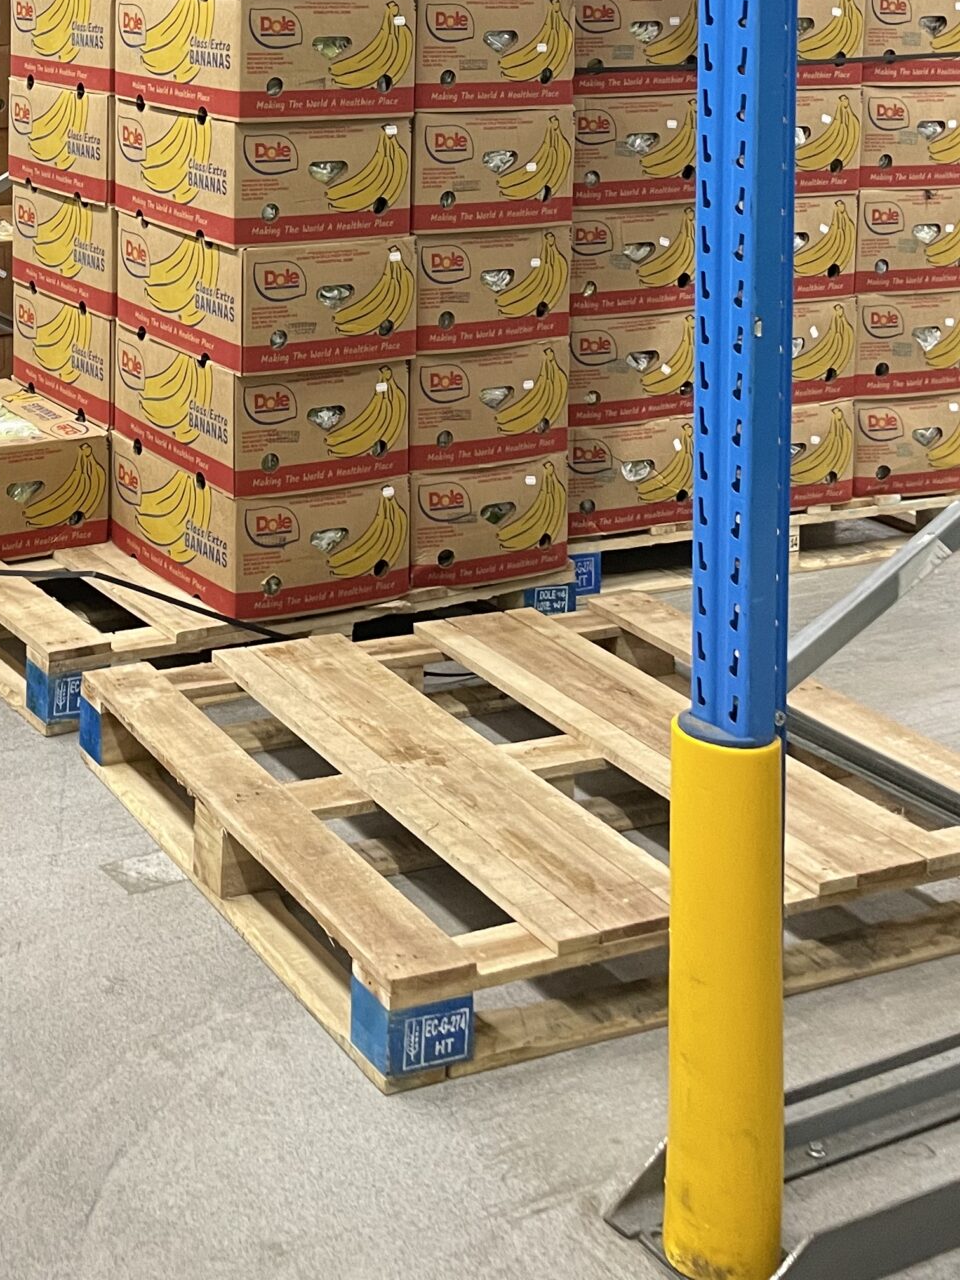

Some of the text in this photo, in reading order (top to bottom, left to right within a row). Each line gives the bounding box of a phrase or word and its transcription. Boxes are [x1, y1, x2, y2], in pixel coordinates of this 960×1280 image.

[16, 1, 34, 19] Dole
[583, 5, 614, 19] Dole
[121, 11, 144, 33] Dole
[259, 15, 296, 33] Dole
[435, 11, 468, 28] Dole
[72, 33, 103, 49] BANANAS
[210, 38, 231, 51] Extra
[190, 51, 231, 69] BANANAS
[14, 102, 30, 121] Dole
[876, 104, 905, 119] Dole
[578, 117, 609, 130] Dole
[121, 125, 144, 149] Dole
[434, 132, 468, 149] Dole
[67, 141, 100, 160] BANANAS
[254, 143, 291, 161] Dole
[208, 162, 227, 178] Extra
[188, 171, 227, 195] BANANAS
[17, 205, 36, 225] Dole
[871, 208, 899, 225] Dole
[575, 228, 607, 241] Dole
[125, 239, 148, 263] Dole
[430, 253, 464, 269] Dole
[263, 269, 300, 289] Dole
[216, 287, 234, 304] Extra
[19, 304, 35, 326] Dole
[195, 294, 235, 322] BANANAS
[870, 312, 898, 326] Dole
[580, 338, 611, 353] Dole
[121, 350, 143, 376] Dole
[430, 372, 463, 388] Dole
[253, 392, 289, 410] Dole
[209, 406, 228, 424] Extra
[867, 414, 897, 430] Dole
[189, 412, 228, 445] BANANAS
[573, 446, 606, 462] Dole
[118, 463, 139, 490] Dole
[428, 490, 464, 507] Dole
[255, 514, 293, 533] Dole
[206, 530, 228, 551] Extra
[184, 532, 228, 568] BANANAS
[435, 1037, 455, 1056] HT
